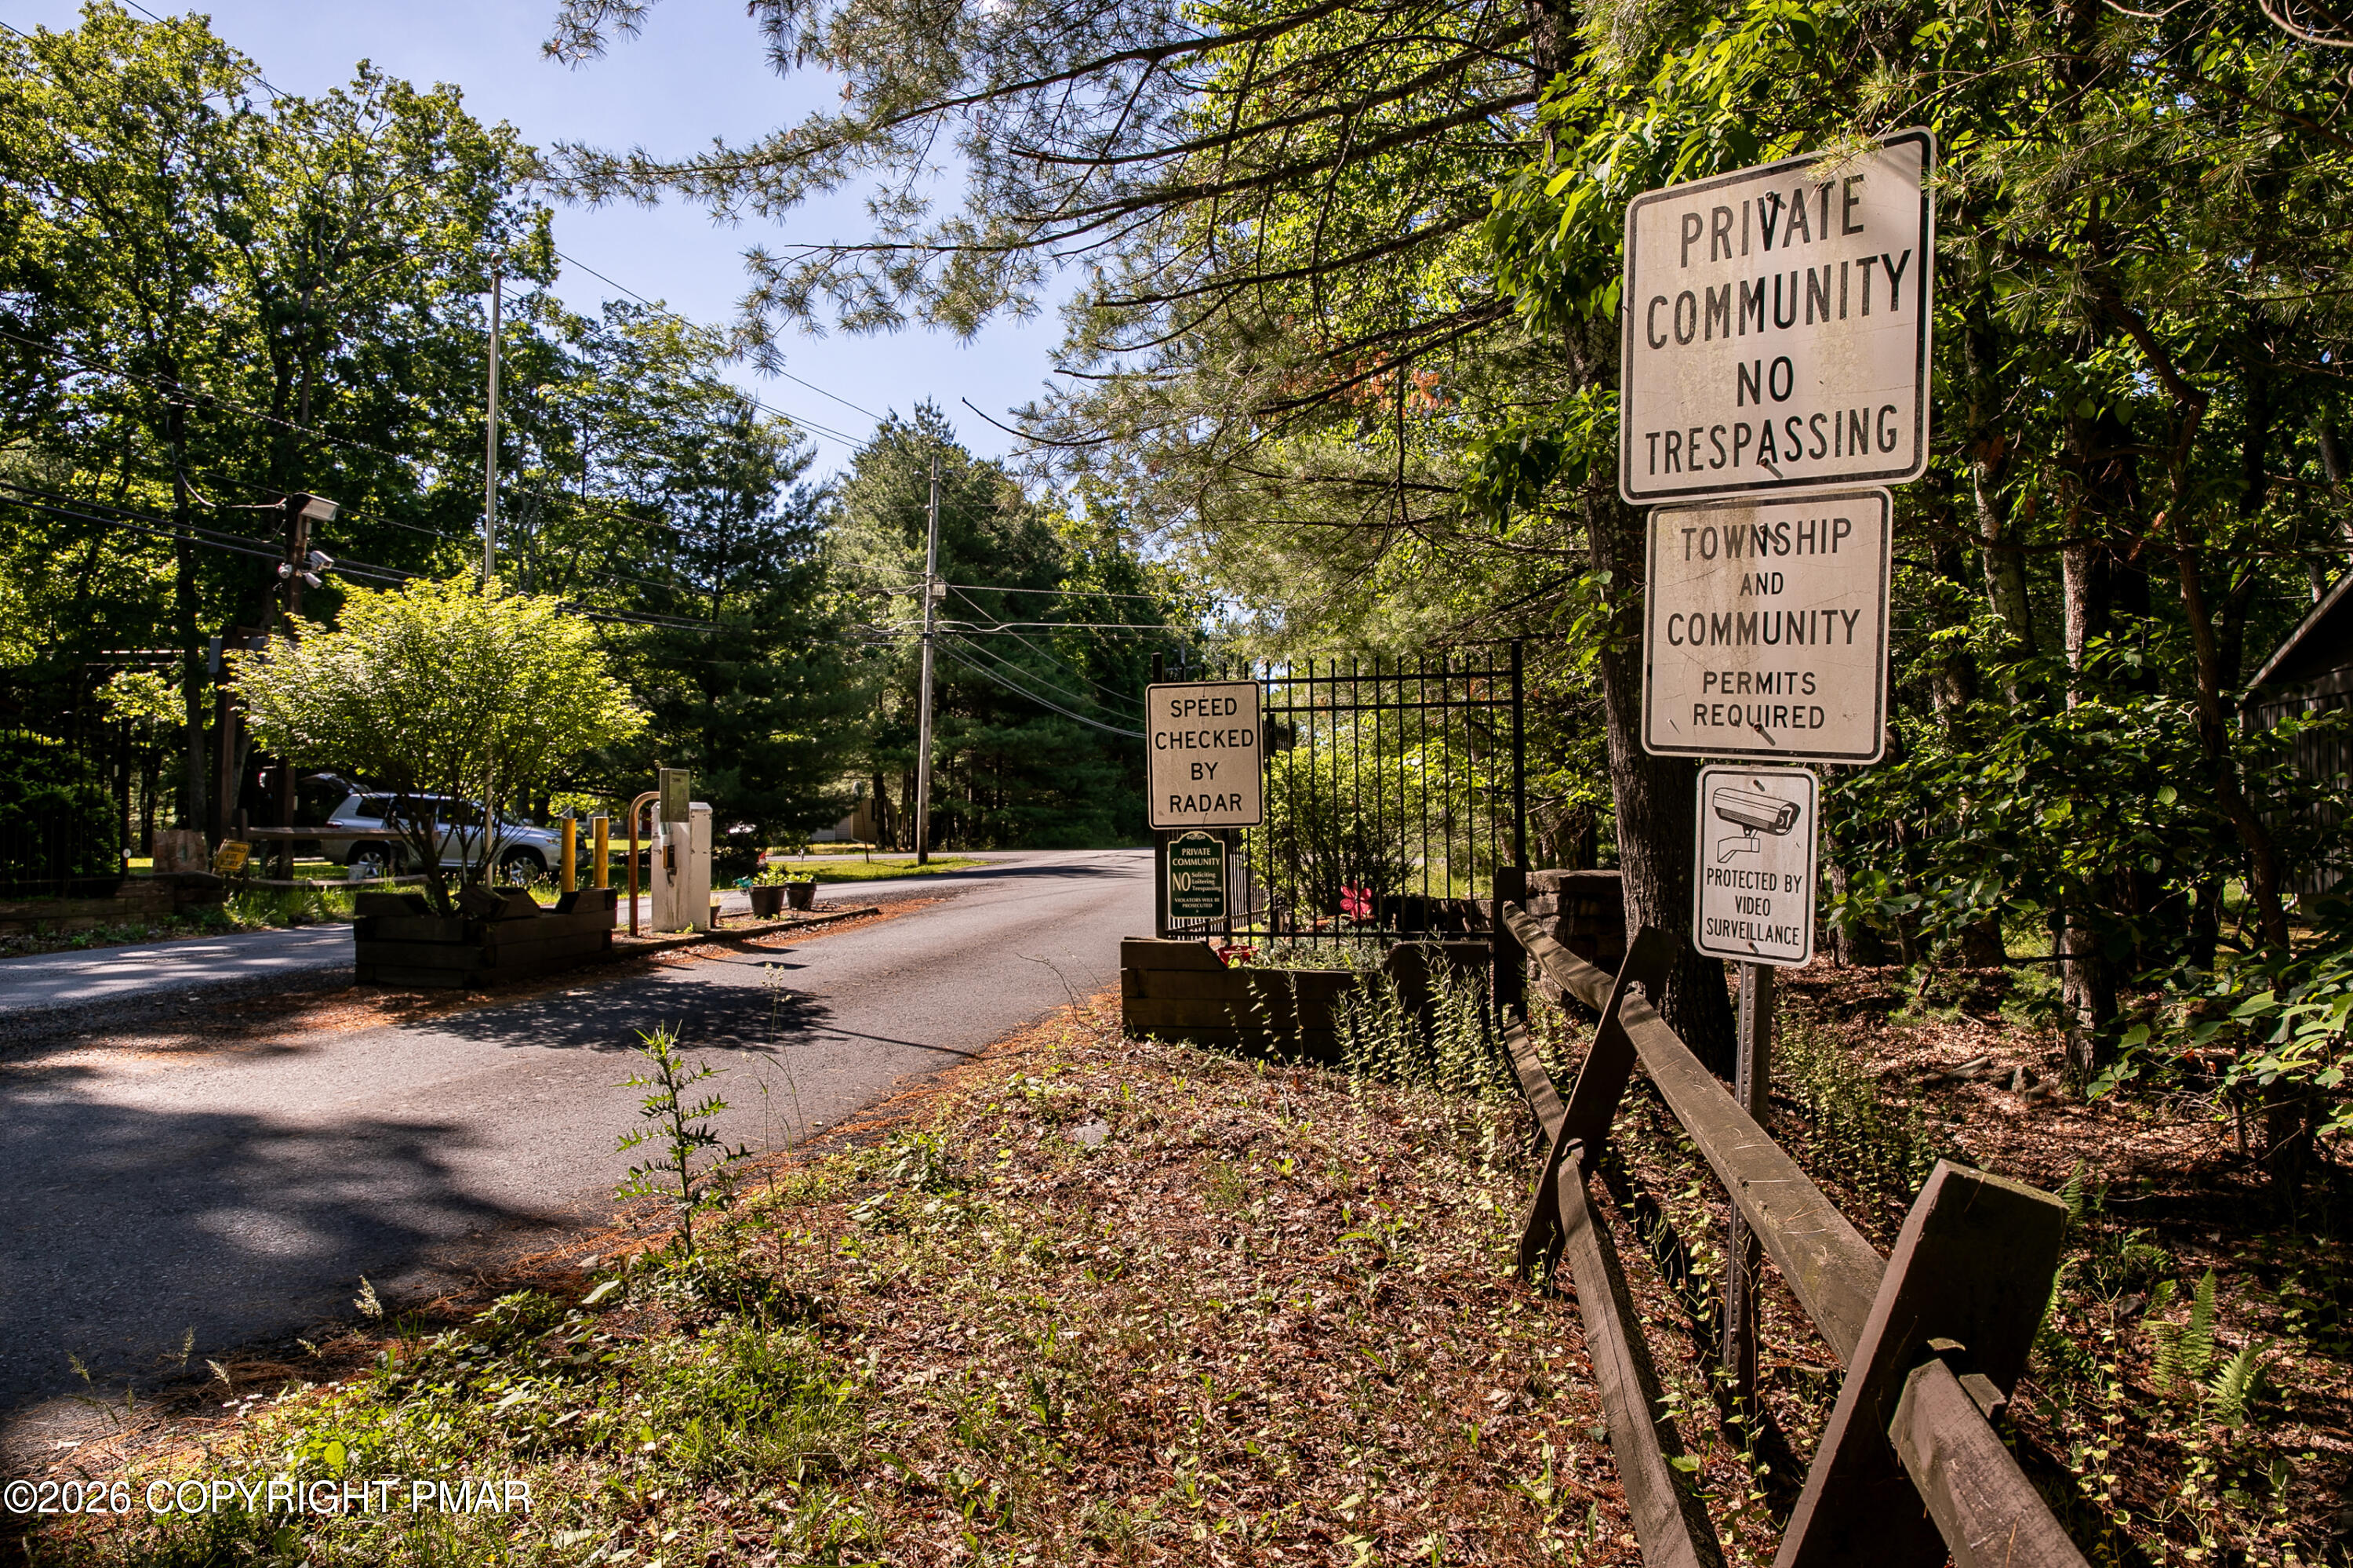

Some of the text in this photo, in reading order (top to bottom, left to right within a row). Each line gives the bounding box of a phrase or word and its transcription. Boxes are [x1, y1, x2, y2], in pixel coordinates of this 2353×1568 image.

[1680, 174, 1865, 268] PRIVATE
[1646, 248, 1912, 350] COMMUNITY
[1737, 355, 1795, 407] NO
[1646, 404, 1898, 475] TRESPASSING
[1681, 518, 1852, 561] TOWNSHIP
[1740, 572, 1784, 596] AND
[1667, 609, 1861, 646] COMMUNITY
[1703, 671, 1817, 696] PERMITS
[1170, 697, 1238, 718] SPEED
[1693, 703, 1825, 729] REQUIRED
[1155, 729, 1254, 750] CHECKED
[1191, 762, 1219, 780] BY
[1169, 793, 1242, 813] RADAR
[1173, 872, 1191, 892] NO
[1707, 868, 1802, 893] PROTECTED BY
[1735, 895, 1771, 916] VIDEO
[1706, 917, 1800, 946] SURVEILLANCE
